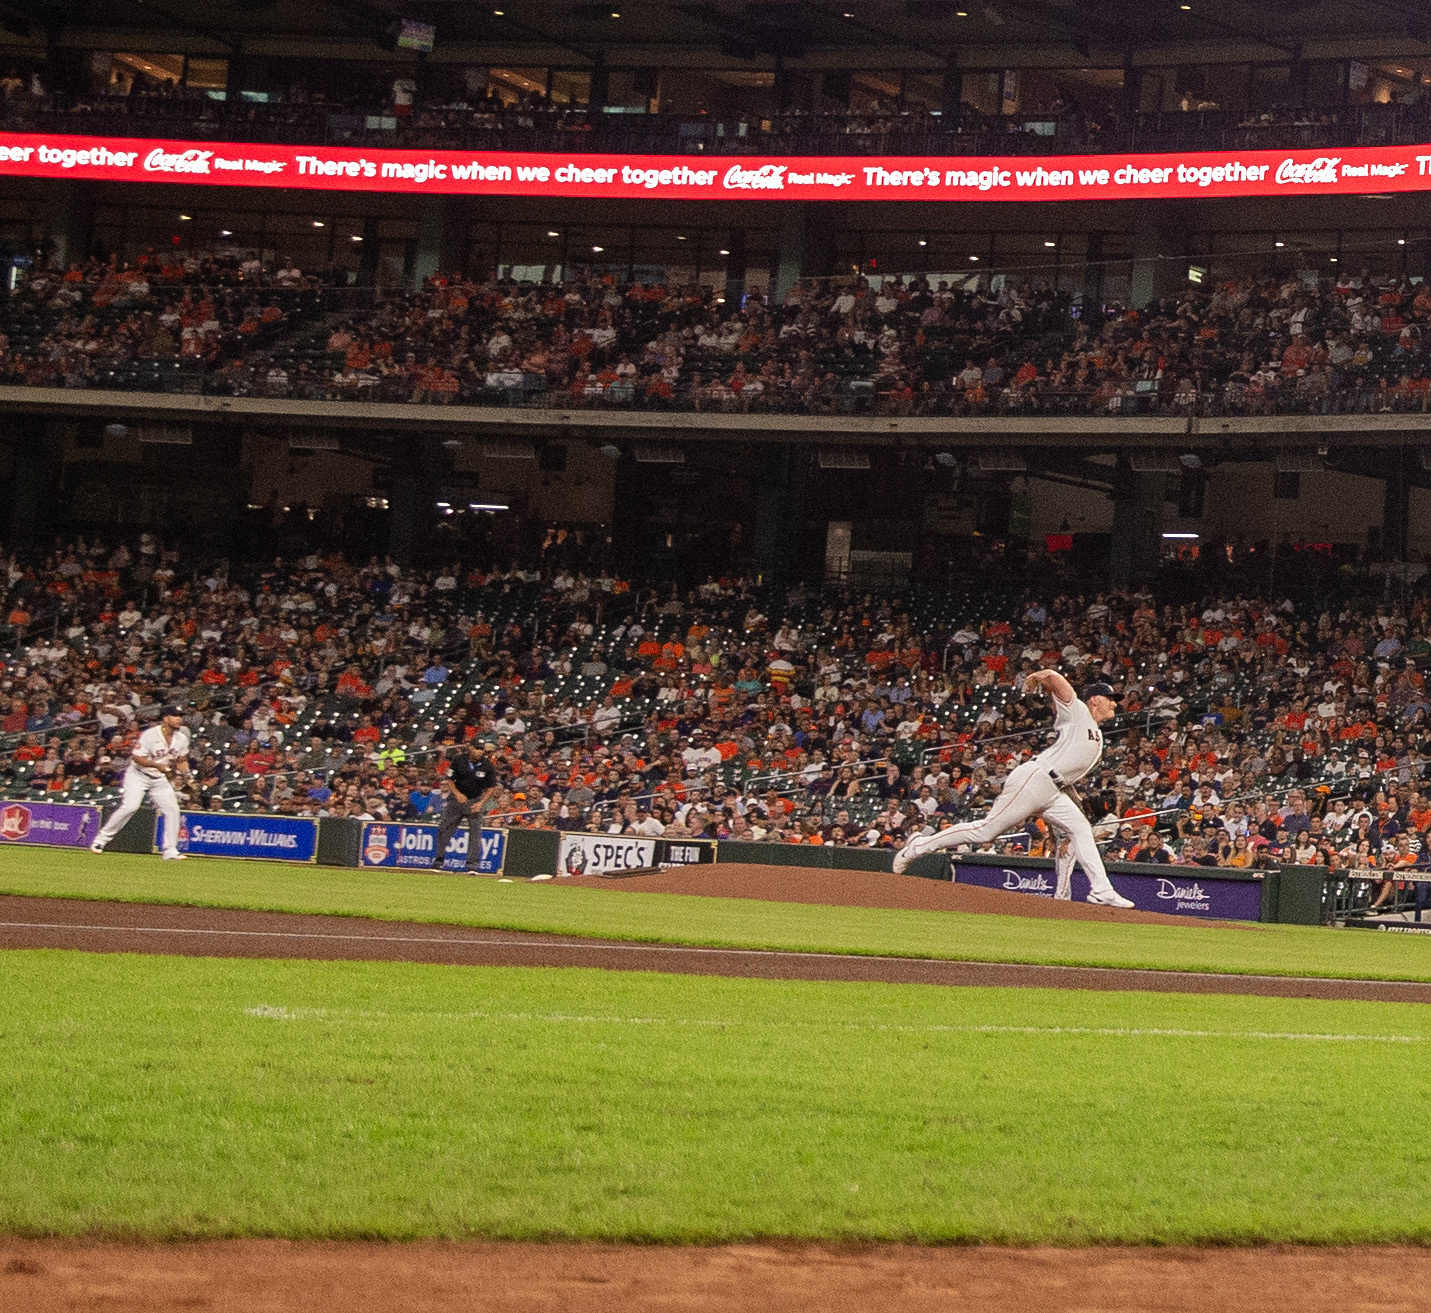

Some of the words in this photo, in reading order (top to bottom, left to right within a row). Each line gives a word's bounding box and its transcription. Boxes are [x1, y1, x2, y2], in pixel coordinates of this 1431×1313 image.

[37, 144, 139, 169] together
[295, 155, 377, 178] There's
[381, 159, 448, 183] magic
[451, 160, 512, 181] when
[516, 166, 551, 182] we
[554, 163, 618, 184] cheer
[621, 165, 719, 189] together
[862, 166, 941, 187] There's
[944, 166, 1012, 191] magic
[1015, 166, 1074, 187] when
[1078, 169, 1110, 186] we
[1113, 164, 1174, 185] cheer
[1176, 161, 1270, 187] together
[394, 828, 433, 850] Join
[445, 832, 500, 860] ody!
[592, 841, 645, 868] SPEC'S
[1002, 869, 1053, 890] Daniel's
[1156, 878, 1210, 899] Daniel's
[1176, 899, 1210, 911] jewelers
